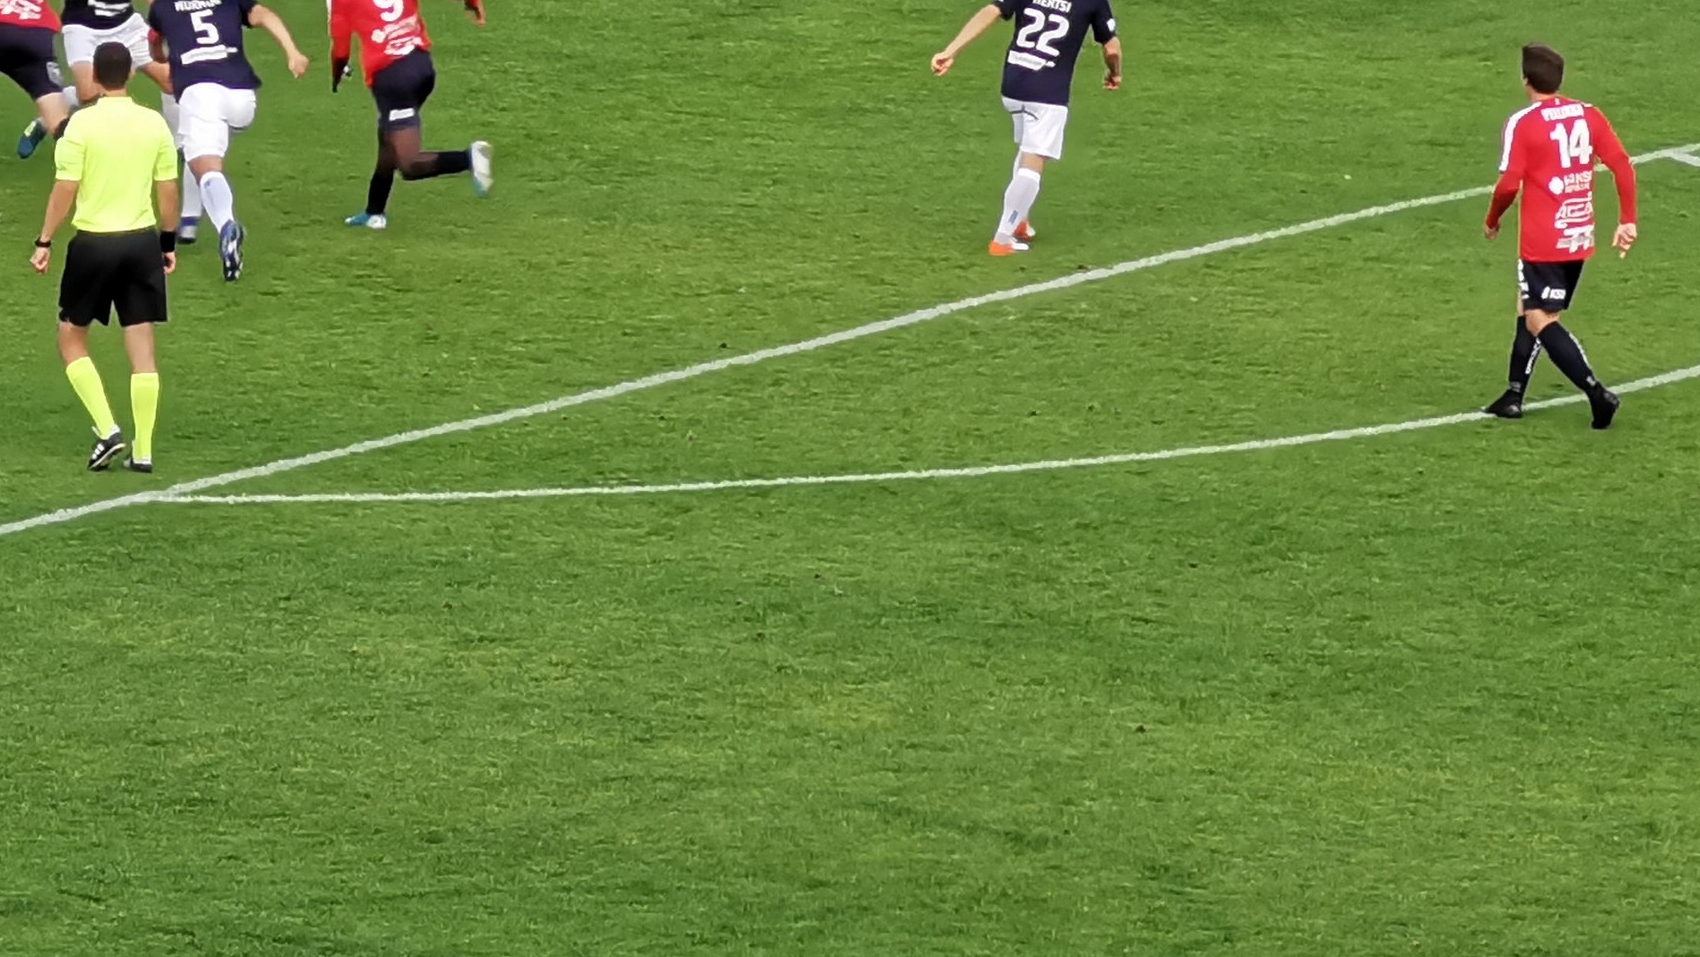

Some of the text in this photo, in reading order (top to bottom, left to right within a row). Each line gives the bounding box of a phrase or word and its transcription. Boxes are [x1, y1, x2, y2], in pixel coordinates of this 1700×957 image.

[190, 9, 220, 45] 5
[1016, 7, 1070, 58] 22
[1550, 119, 1593, 169] 14
